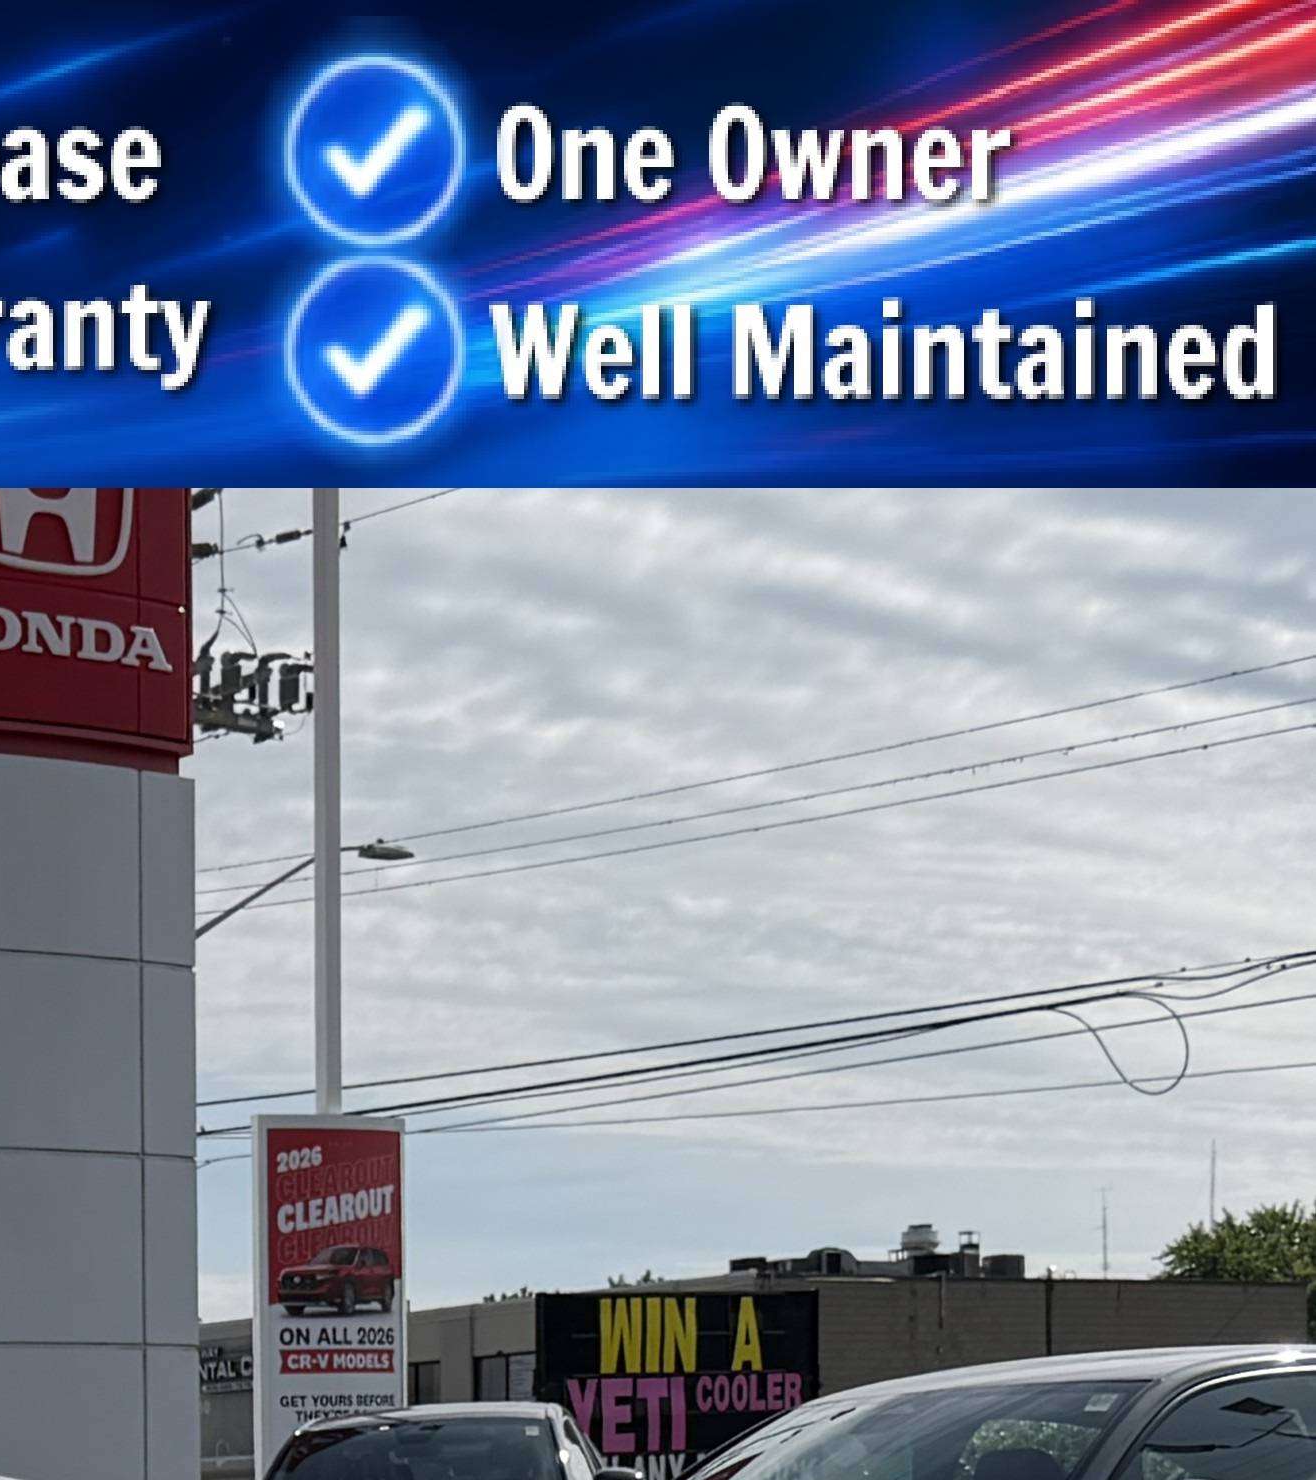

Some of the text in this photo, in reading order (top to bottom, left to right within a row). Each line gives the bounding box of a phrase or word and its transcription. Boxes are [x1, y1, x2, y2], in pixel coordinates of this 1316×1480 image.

[277, 1145, 323, 1173] 2026
[276, 1184, 395, 1234] CLEAROUT
[279, 1326, 395, 1346] ON ALL 2026
[599, 1296, 763, 1374] WIN A
[199, 1359, 237, 1381] NTAL
[286, 1352, 391, 1370] CR-V MODELS
[279, 1393, 396, 1408] GET YOURS BEFORE
[567, 1373, 803, 1453] YETI COOLER
